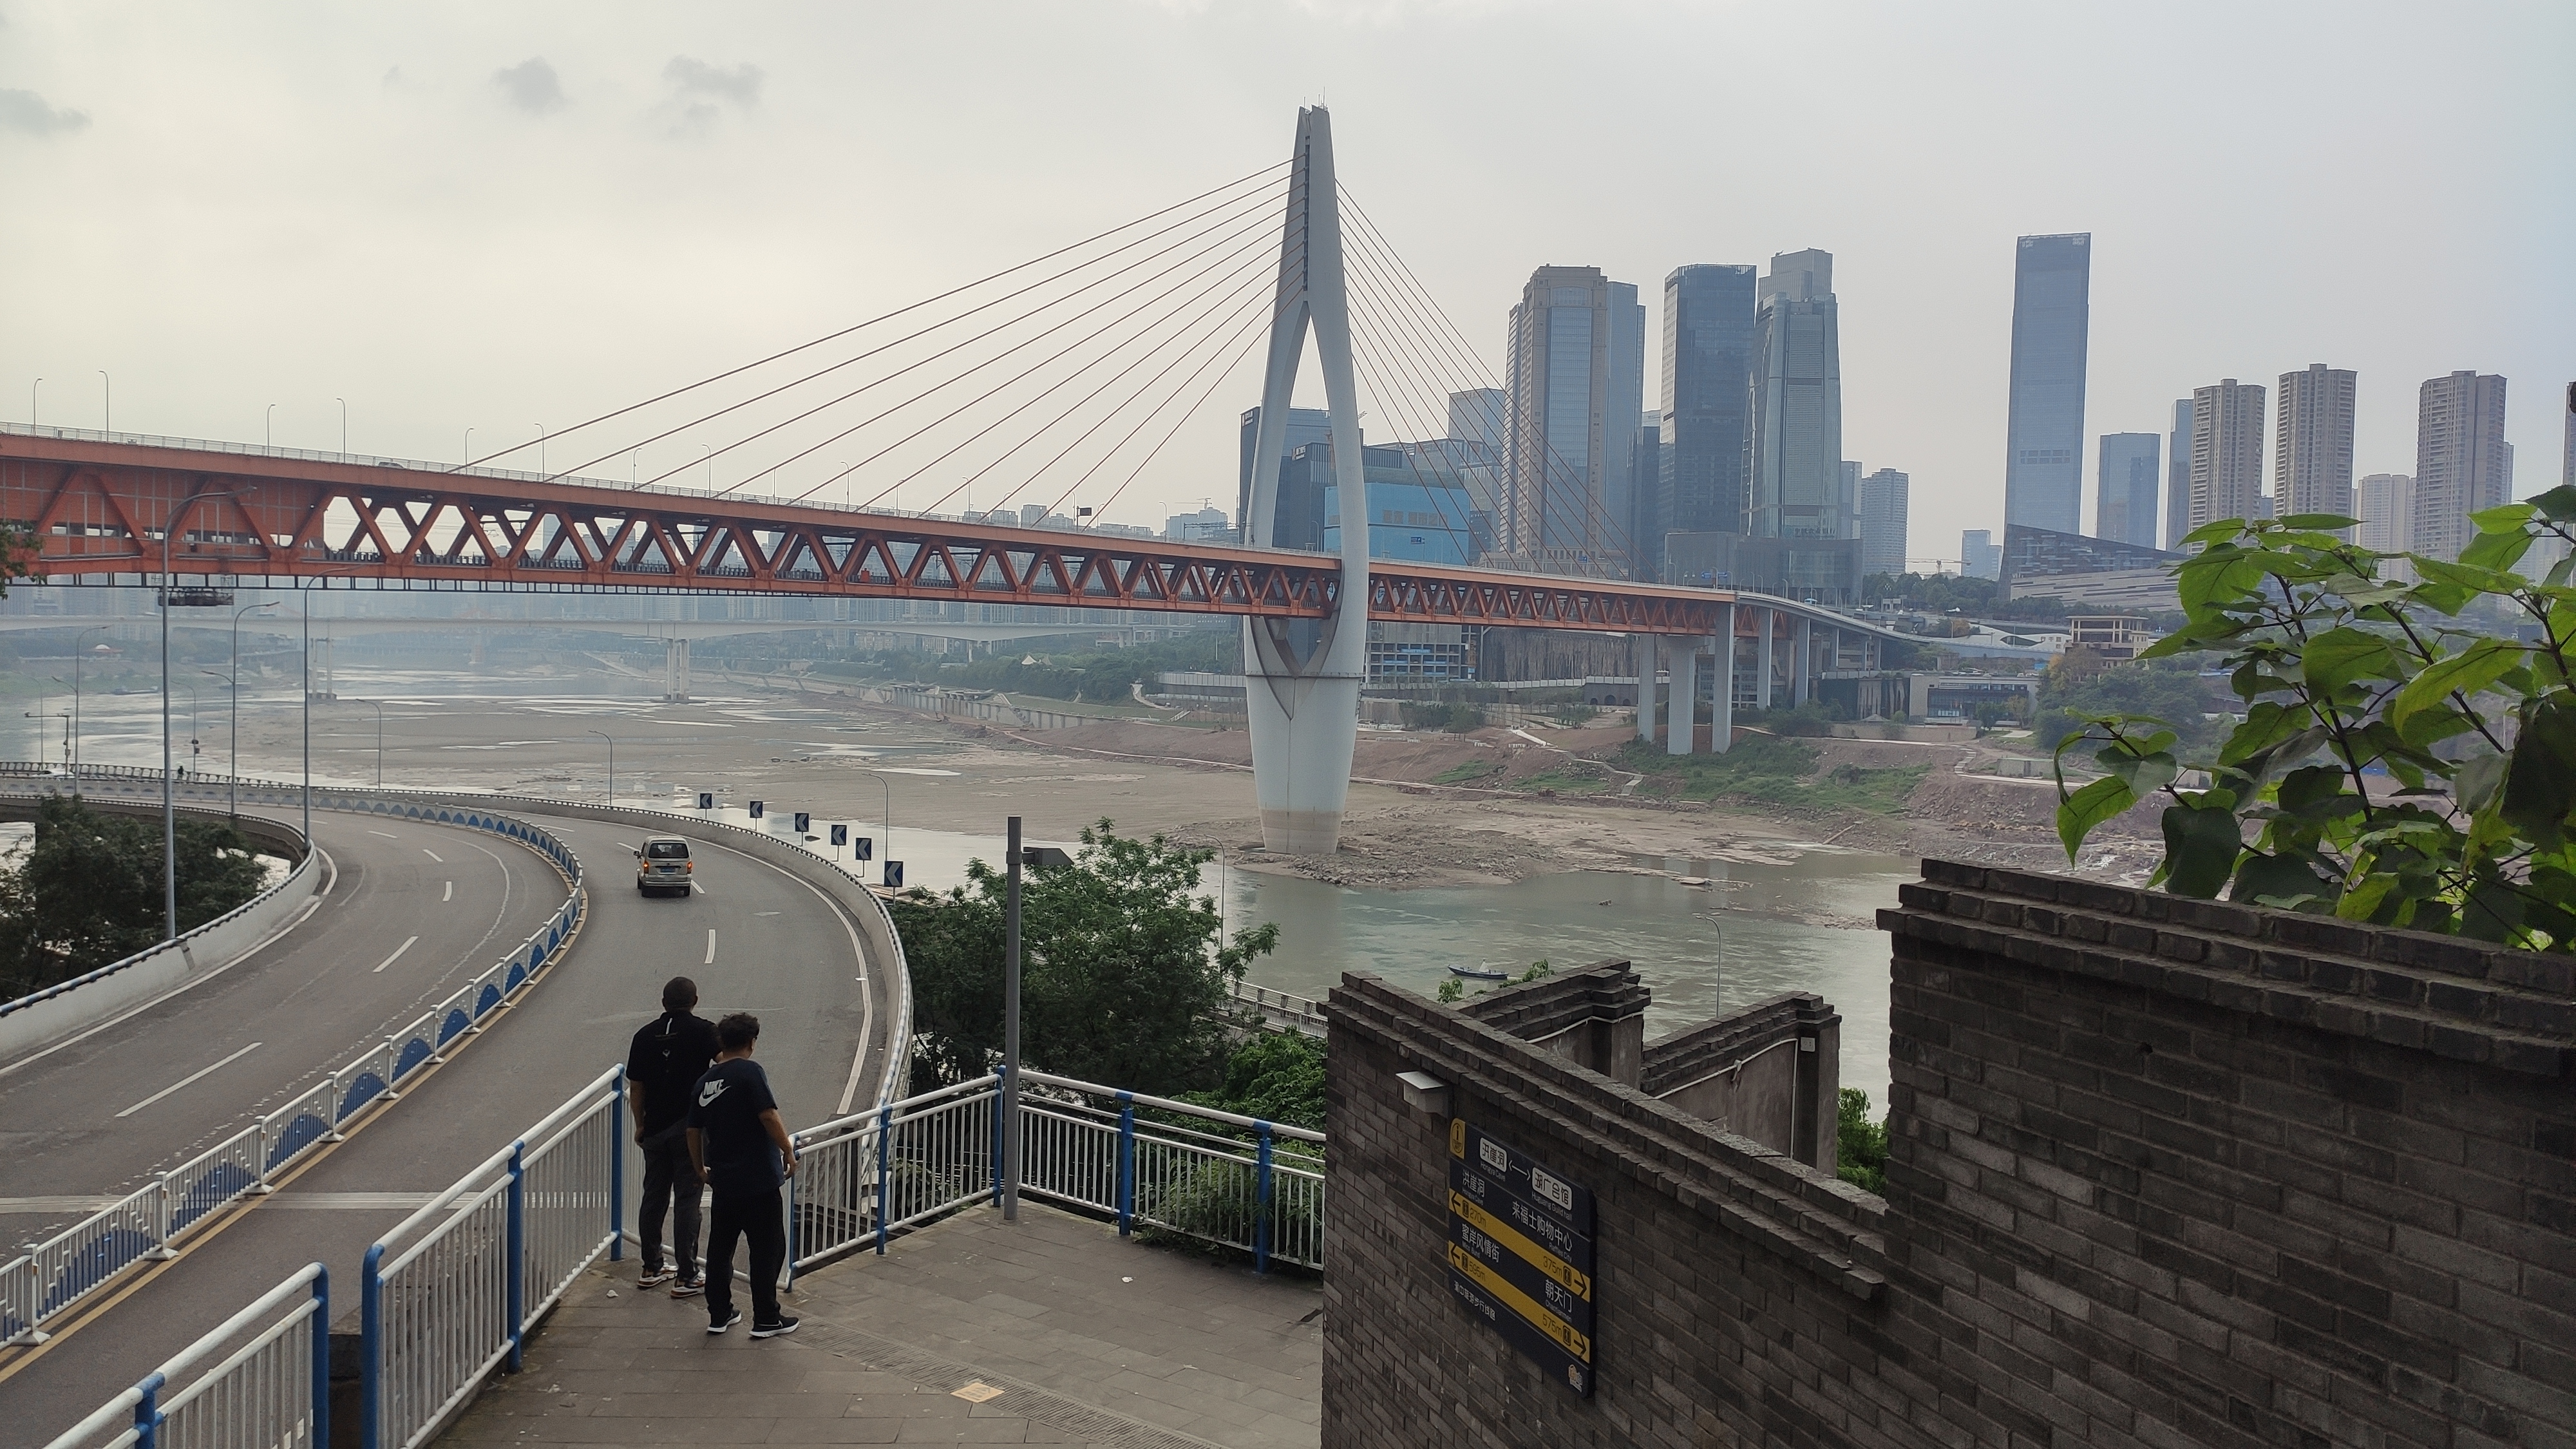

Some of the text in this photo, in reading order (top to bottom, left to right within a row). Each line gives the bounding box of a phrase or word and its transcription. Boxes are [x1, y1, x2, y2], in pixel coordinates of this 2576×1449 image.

[703, 1079, 724, 1095] NIKE
[1482, 1142, 1505, 1168] 洪崖洞
[1463, 1169, 1485, 1198] 洪崖洞
[1535, 1171, 1569, 1205] 湖广会馆
[1470, 1208, 1486, 1227] 270m
[1512, 1200, 1573, 1252] 来福士购物中心
[1462, 1223, 1499, 1263] 蜜岸风情街
[1543, 1256, 1562, 1276] 375m
[1564, 1251, 1572, 1263] City
[1469, 1261, 1486, 1282] 595m
[1546, 1278, 1572, 1313] 朝天门
[1542, 1313, 1562, 1338] 575m
